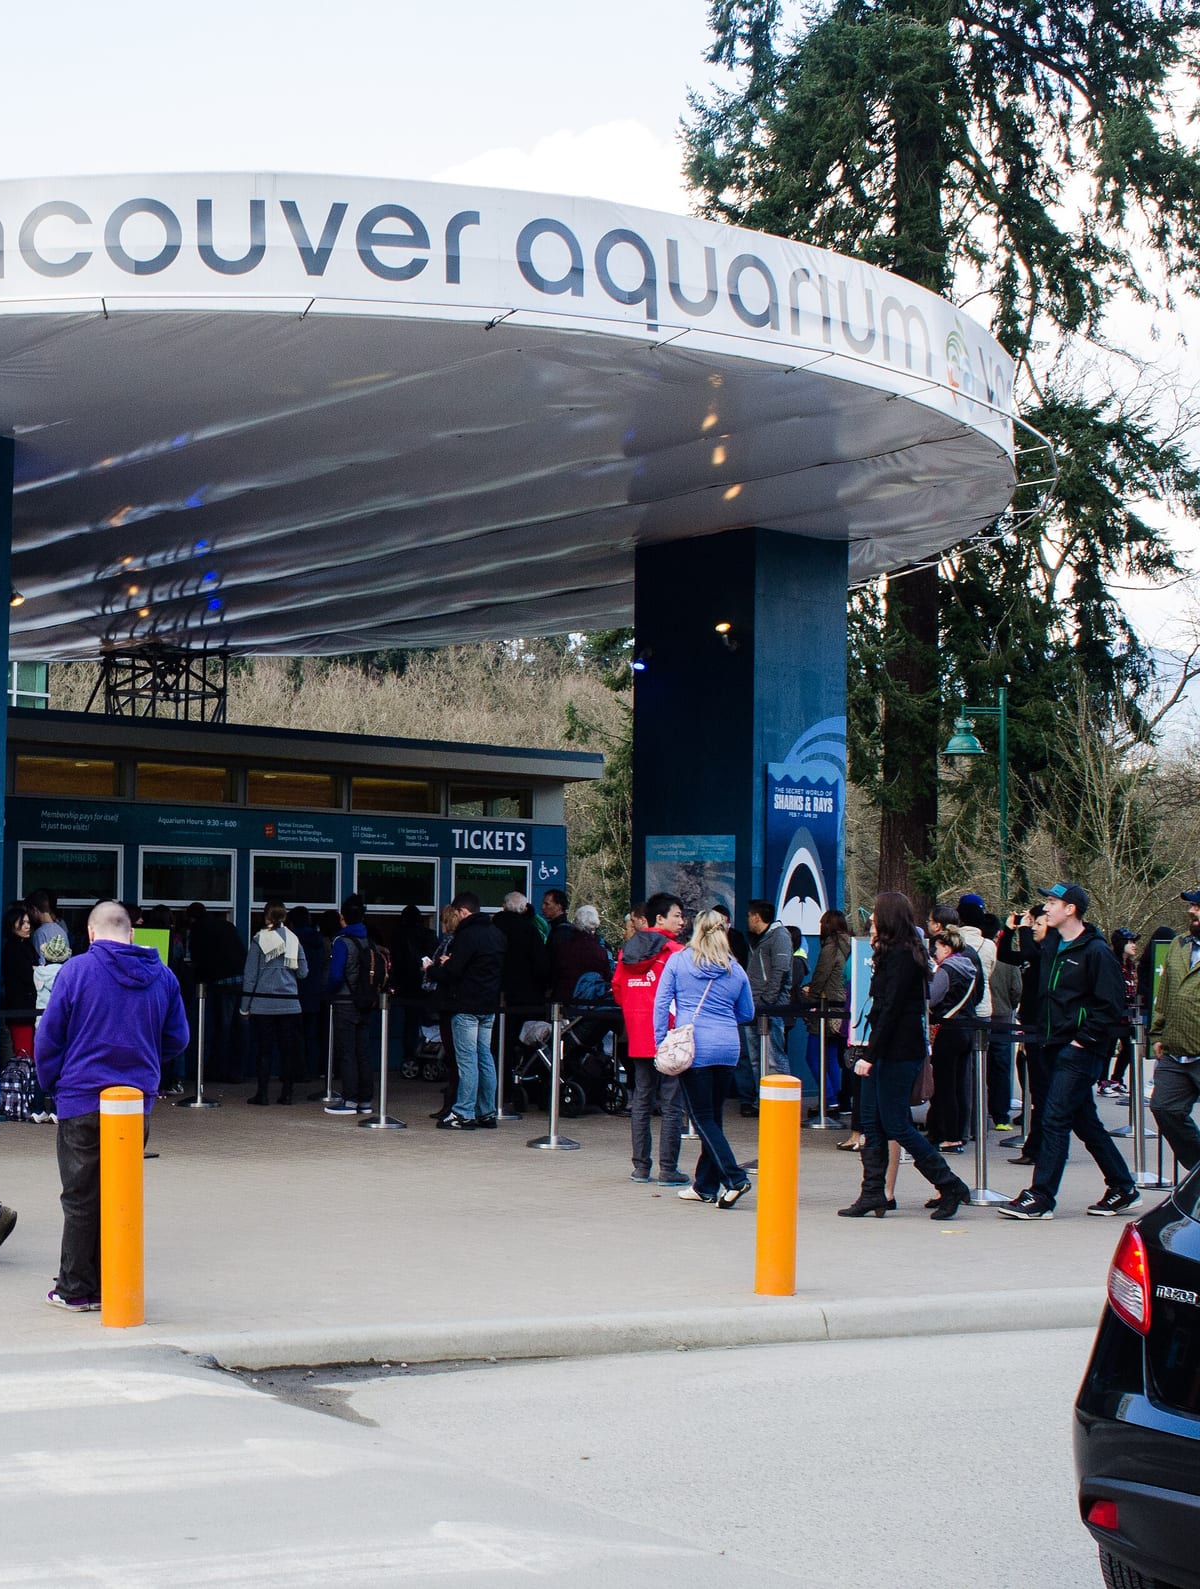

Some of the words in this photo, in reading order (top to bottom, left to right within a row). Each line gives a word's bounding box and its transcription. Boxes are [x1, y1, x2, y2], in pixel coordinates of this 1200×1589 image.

[515, 217, 933, 378] aquarium
[774, 793, 804, 811] SHARKS
[805, 796, 812, 812] &
[813, 796, 833, 813] RAYS
[41, 810, 79, 821] Membership
[79, 813, 93, 821] pays
[93, 812, 103, 821] for
[158, 816, 185, 825] Aquarium
[186, 817, 204, 825] Hours:
[46, 822, 59, 831] just
[451, 828, 526, 852] TICKETS
[176, 856, 214, 865] MEMBERS
[279, 860, 305, 870] Tickets
[382, 863, 406, 873] Tickets
[1155, 1285, 1198, 1304] mazda
